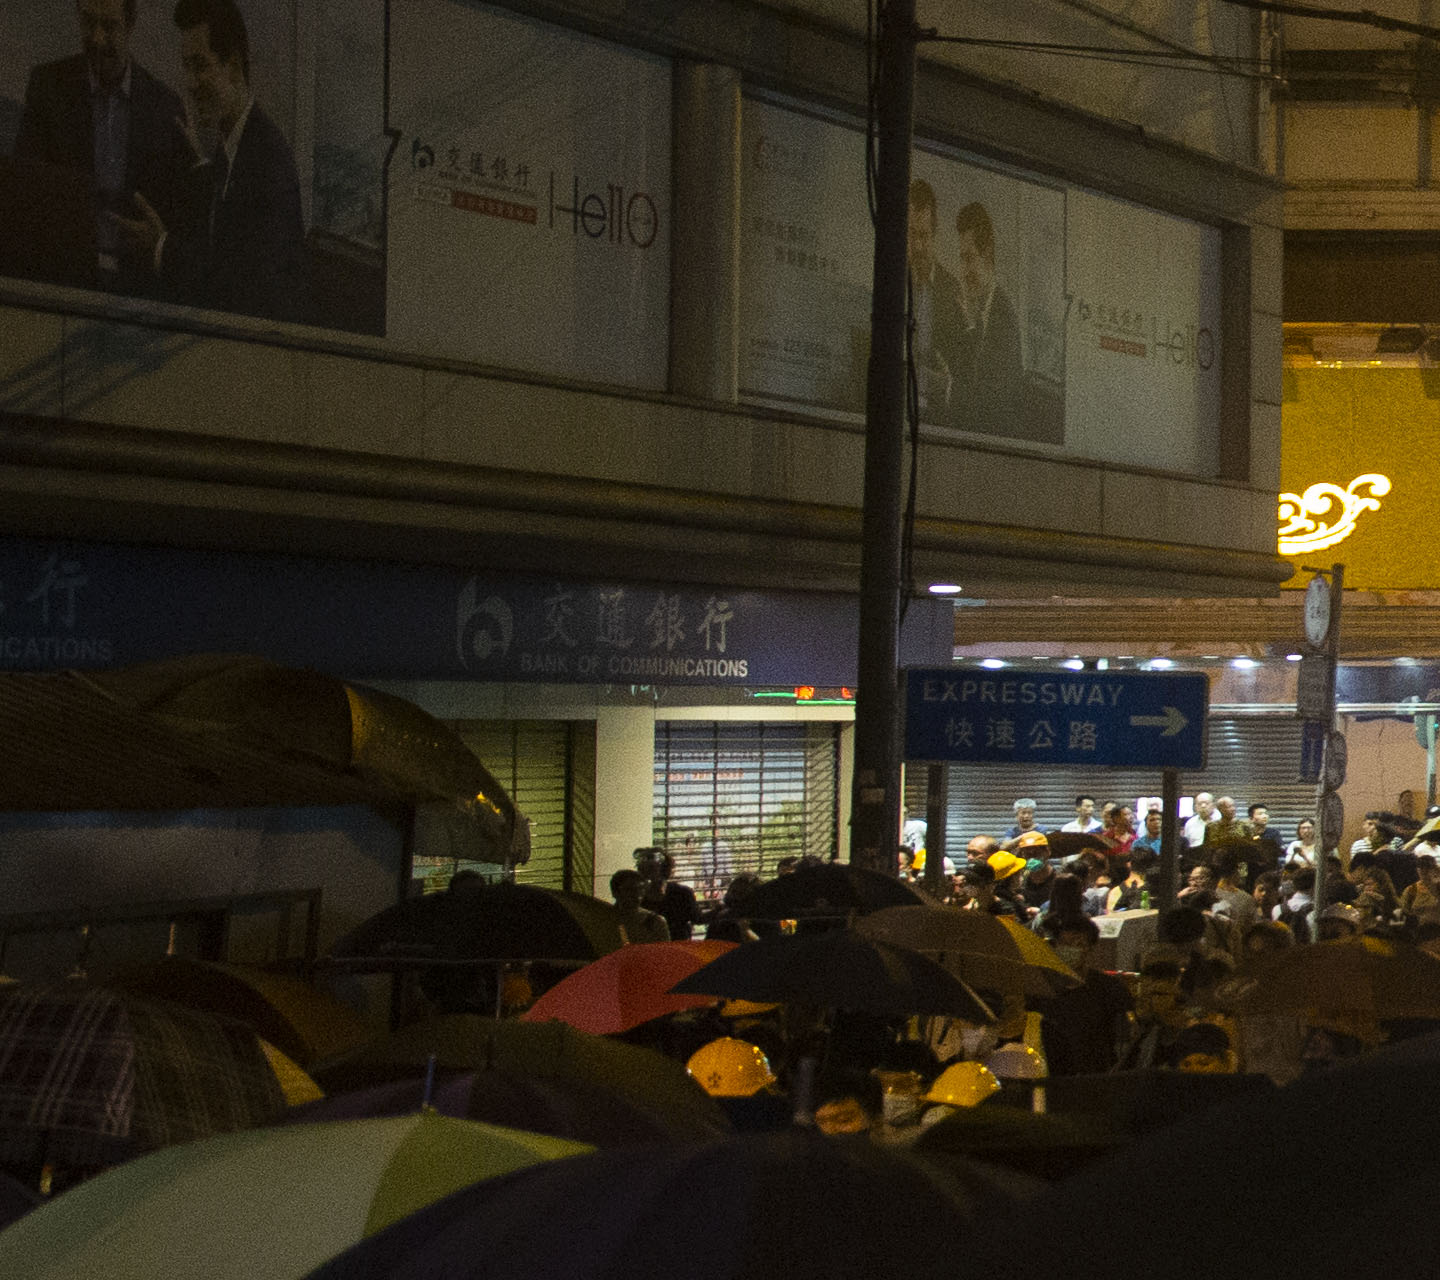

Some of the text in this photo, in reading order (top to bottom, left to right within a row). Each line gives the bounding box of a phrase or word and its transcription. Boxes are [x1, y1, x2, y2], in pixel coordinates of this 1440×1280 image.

[539, 582, 734, 654] 交通銀行
[520, 653, 749, 678] BANK OF COMMUNICATIONS
[922, 680, 1125, 708] EXPRESSWAY
[944, 717, 1099, 751] 快速公路
